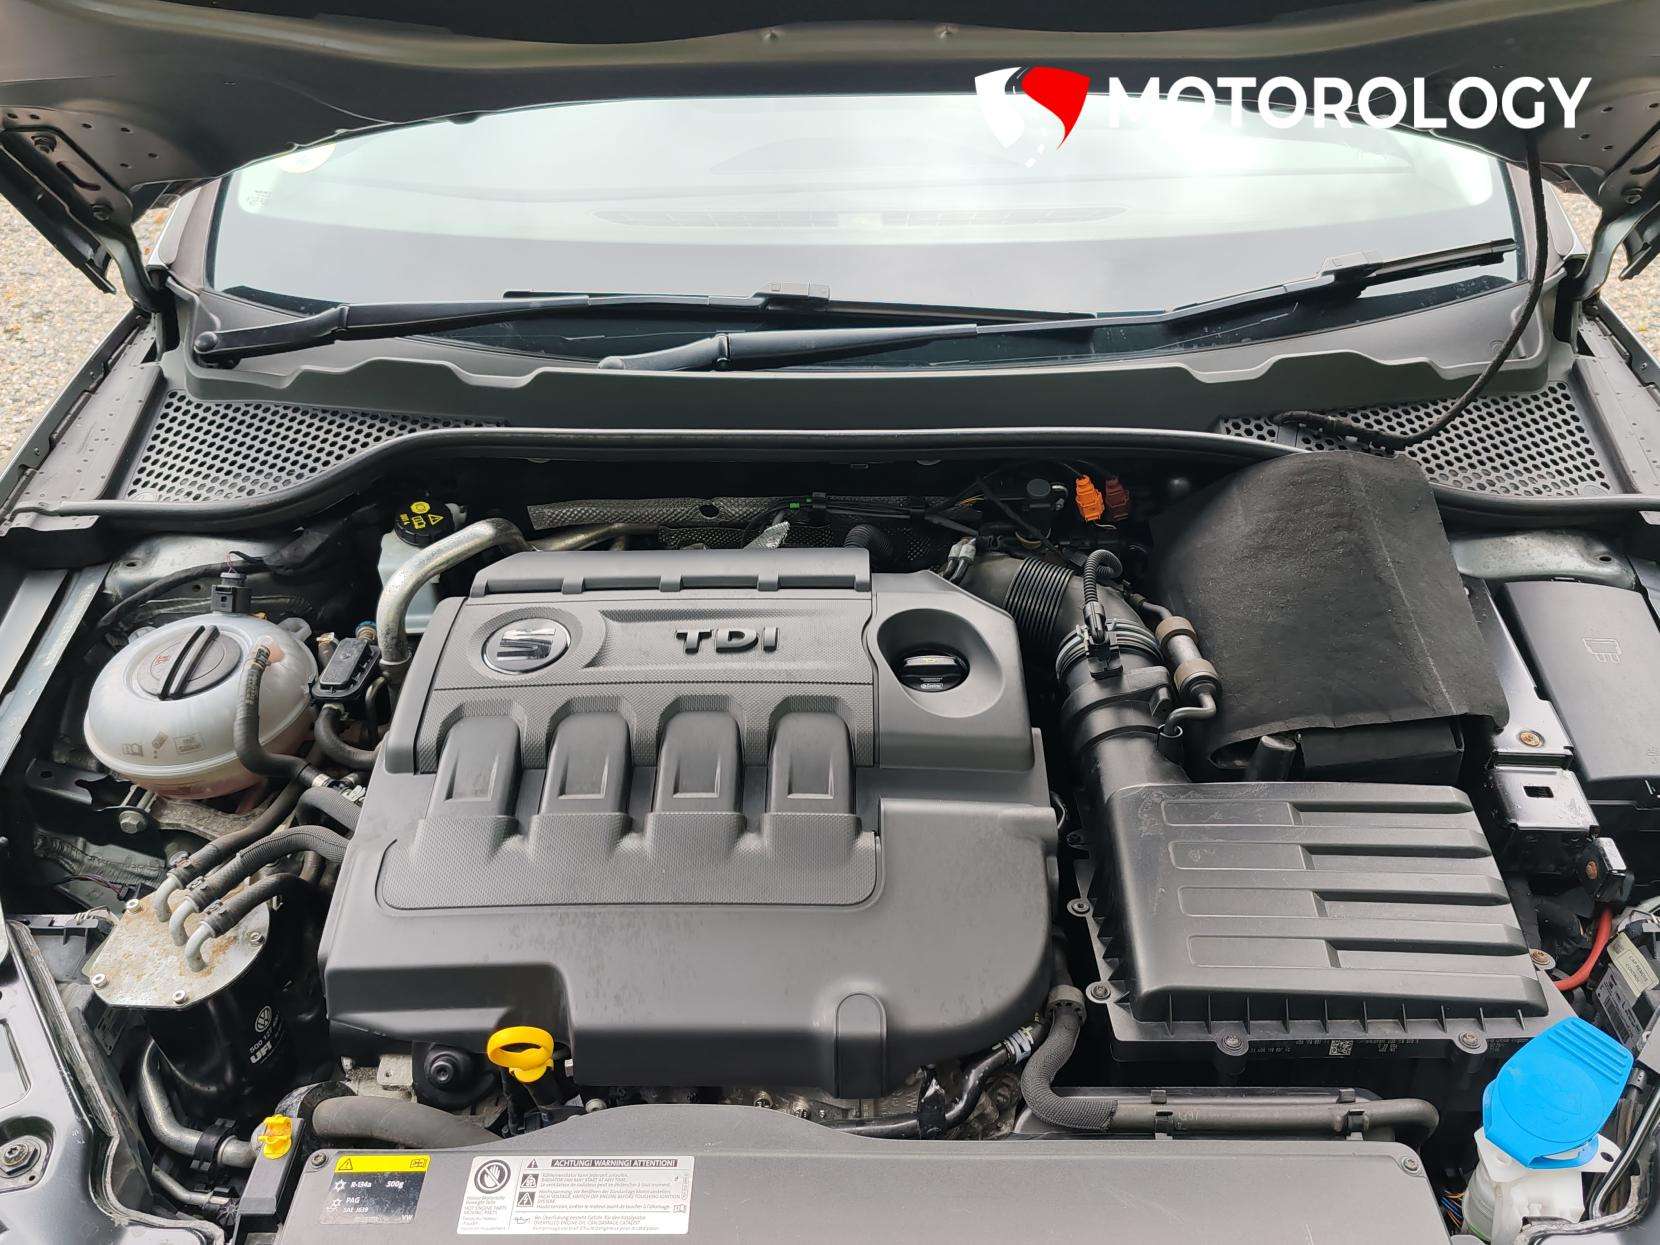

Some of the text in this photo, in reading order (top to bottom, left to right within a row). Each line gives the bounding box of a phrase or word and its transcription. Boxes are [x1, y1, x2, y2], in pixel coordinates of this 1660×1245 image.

[675, 626, 779, 654] TDI
[554, 1159, 676, 1168] ACHTUNG! WARNING! ATTENTION!
[386, 1180, 404, 1189] 500g
